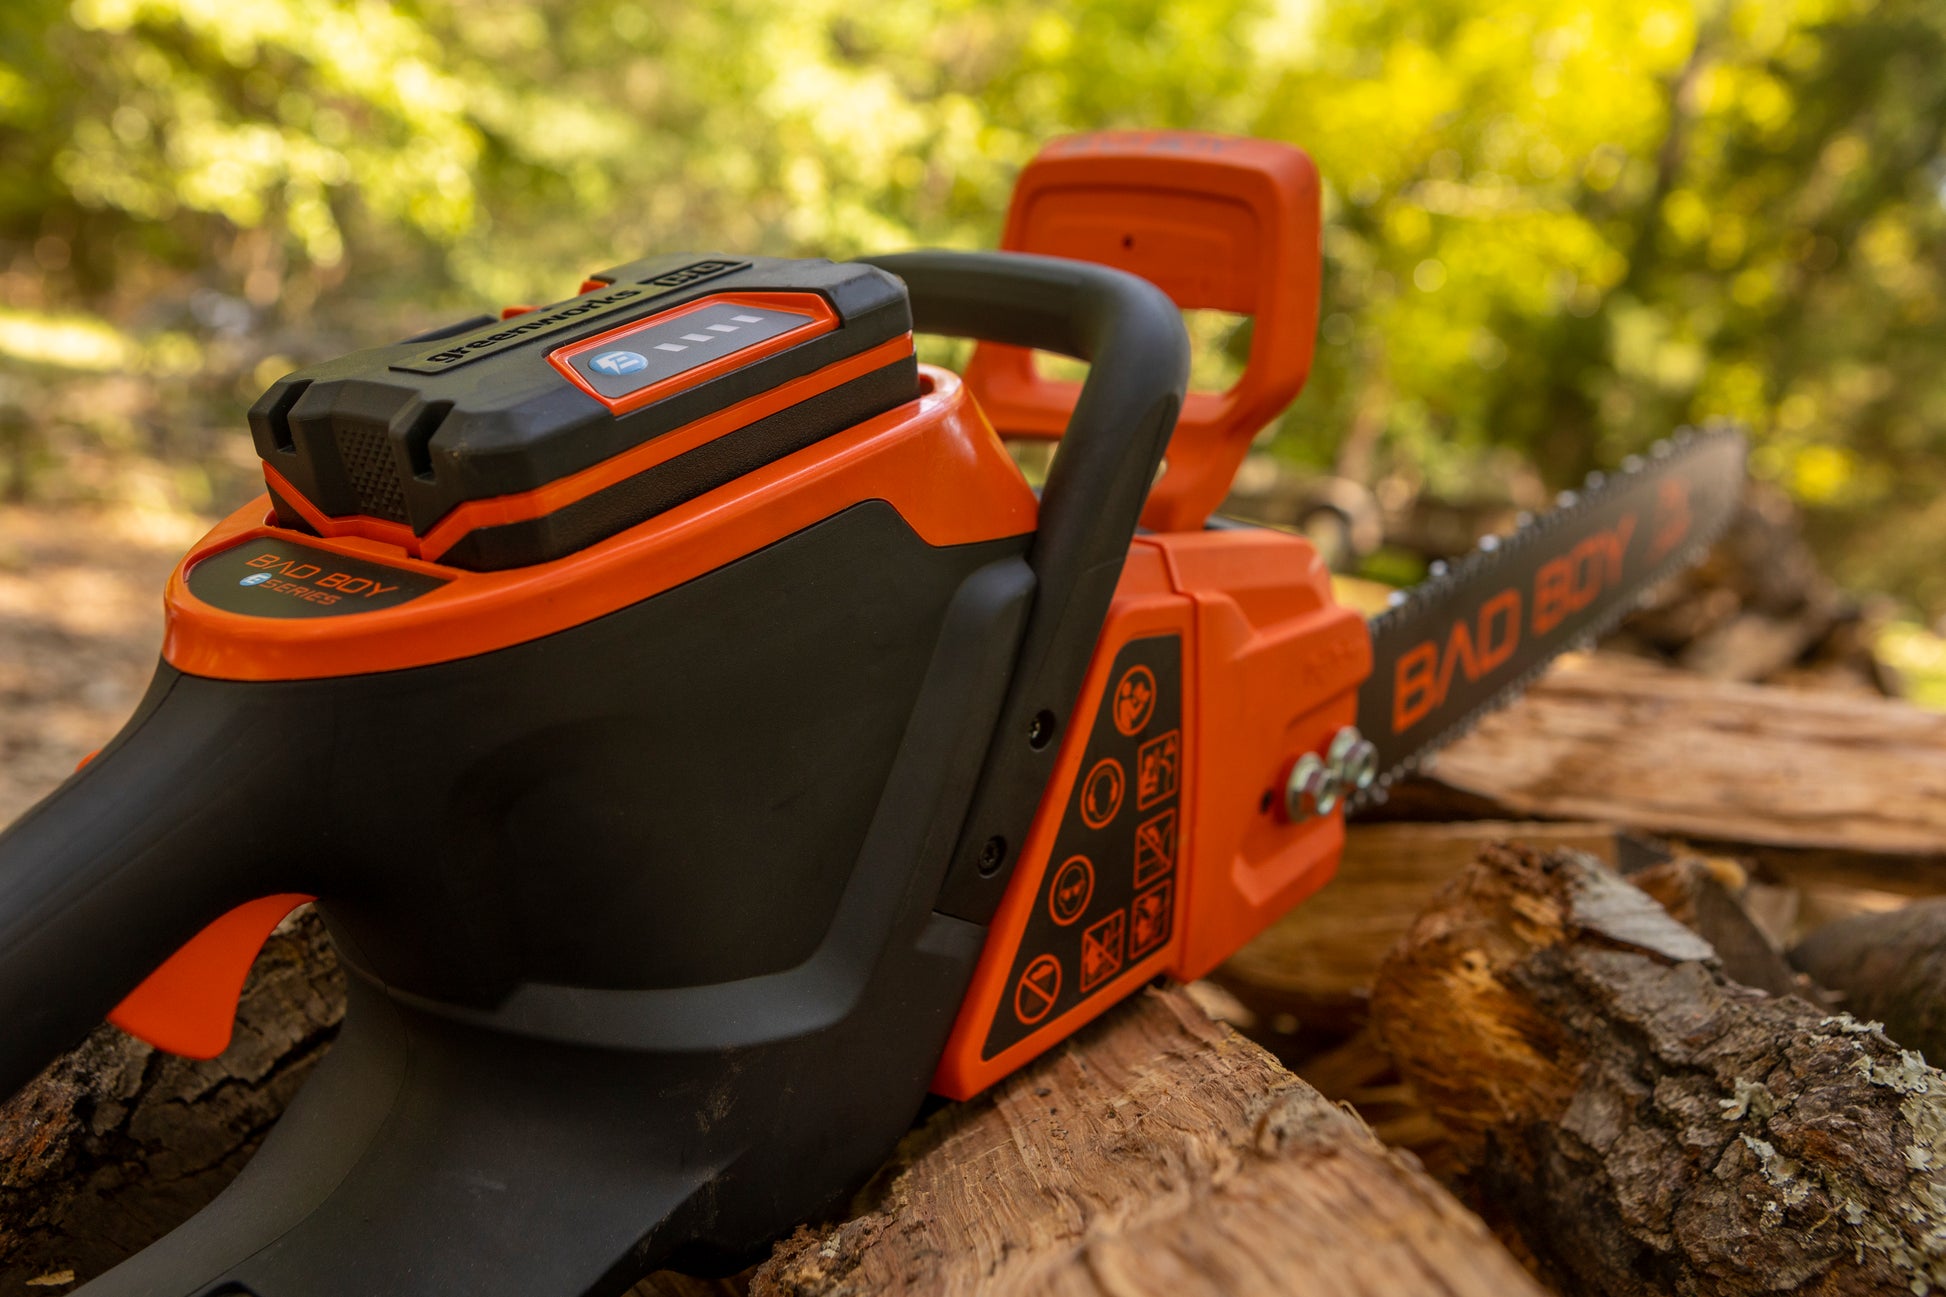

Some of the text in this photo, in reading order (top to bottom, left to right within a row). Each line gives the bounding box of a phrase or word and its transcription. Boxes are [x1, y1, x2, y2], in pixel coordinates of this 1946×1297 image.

[427, 289, 642, 364] greenworks
[245, 553, 399, 597] BAD BOY
[258, 579, 343, 606] SERIES
[1393, 514, 1638, 734] BAD BOY
